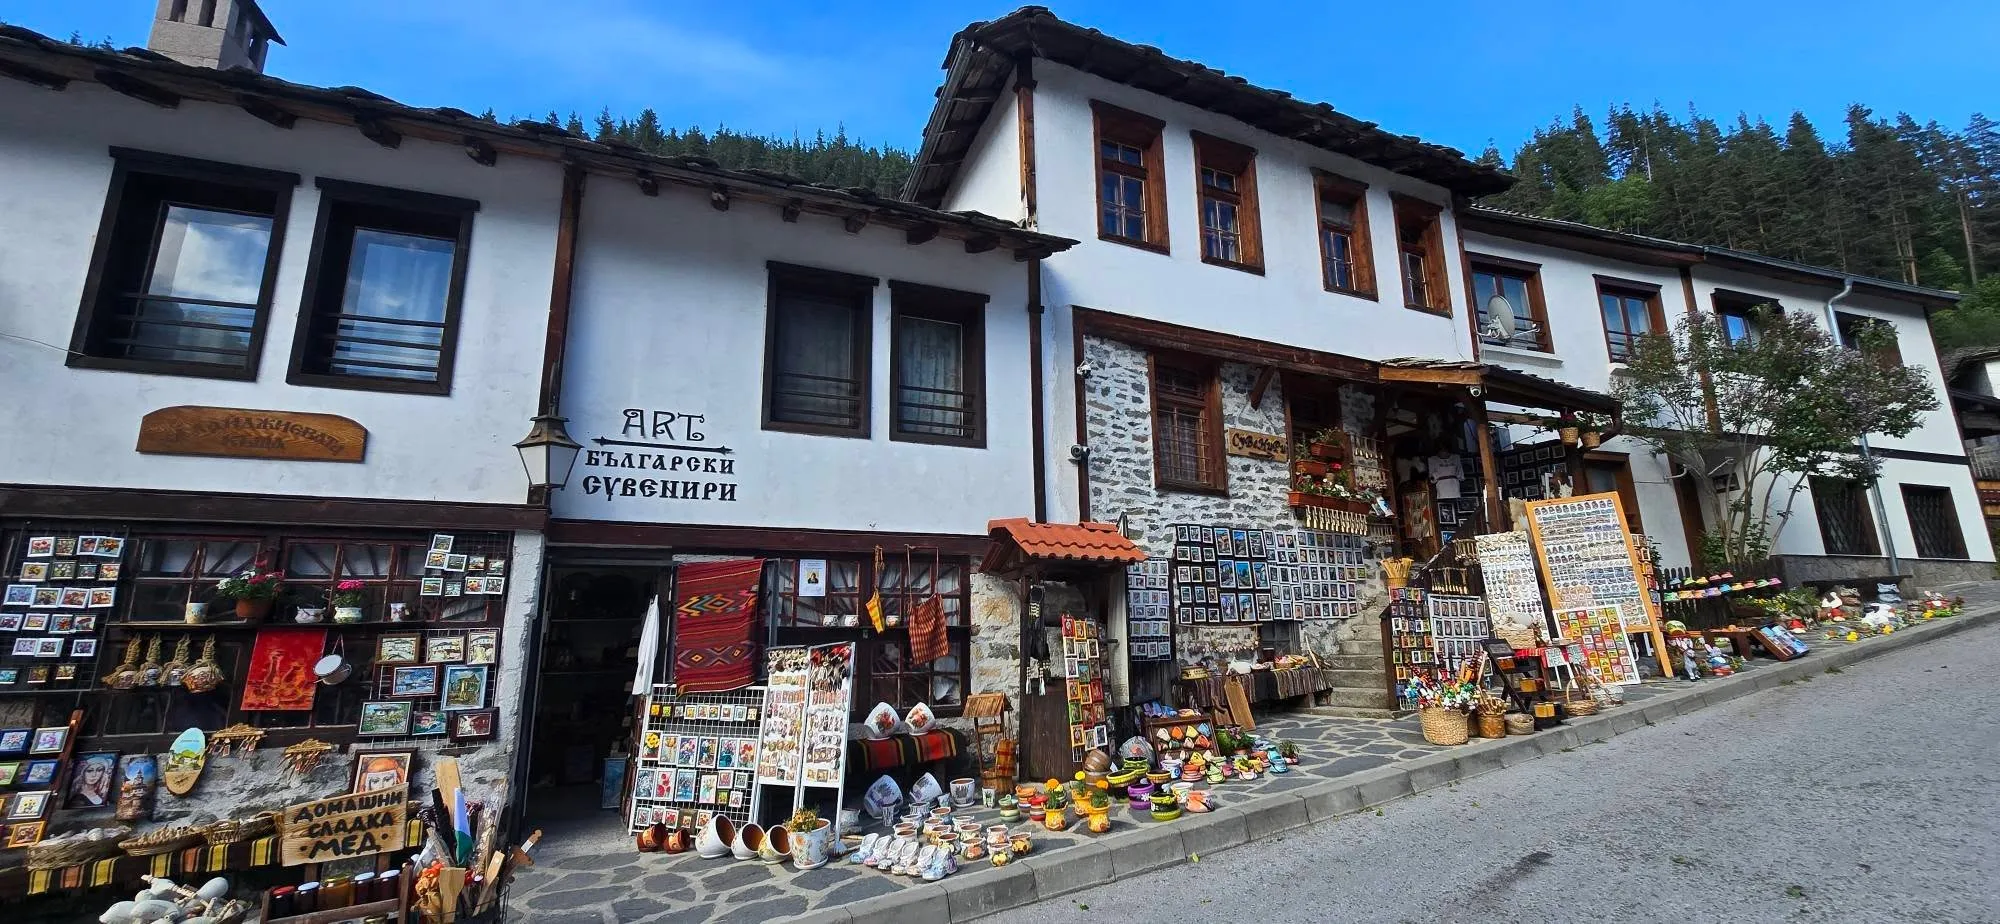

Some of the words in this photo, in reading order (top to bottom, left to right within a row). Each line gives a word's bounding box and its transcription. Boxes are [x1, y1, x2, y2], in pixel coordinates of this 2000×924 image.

[621, 408, 705, 441] ART
[585, 450, 735, 474] БЪЛГАРСКИ
[582, 475, 737, 501] СУВЕНИРИ
[293, 791, 403, 824] ДОМАШНИ
[308, 811, 393, 838] СЛАДКА
